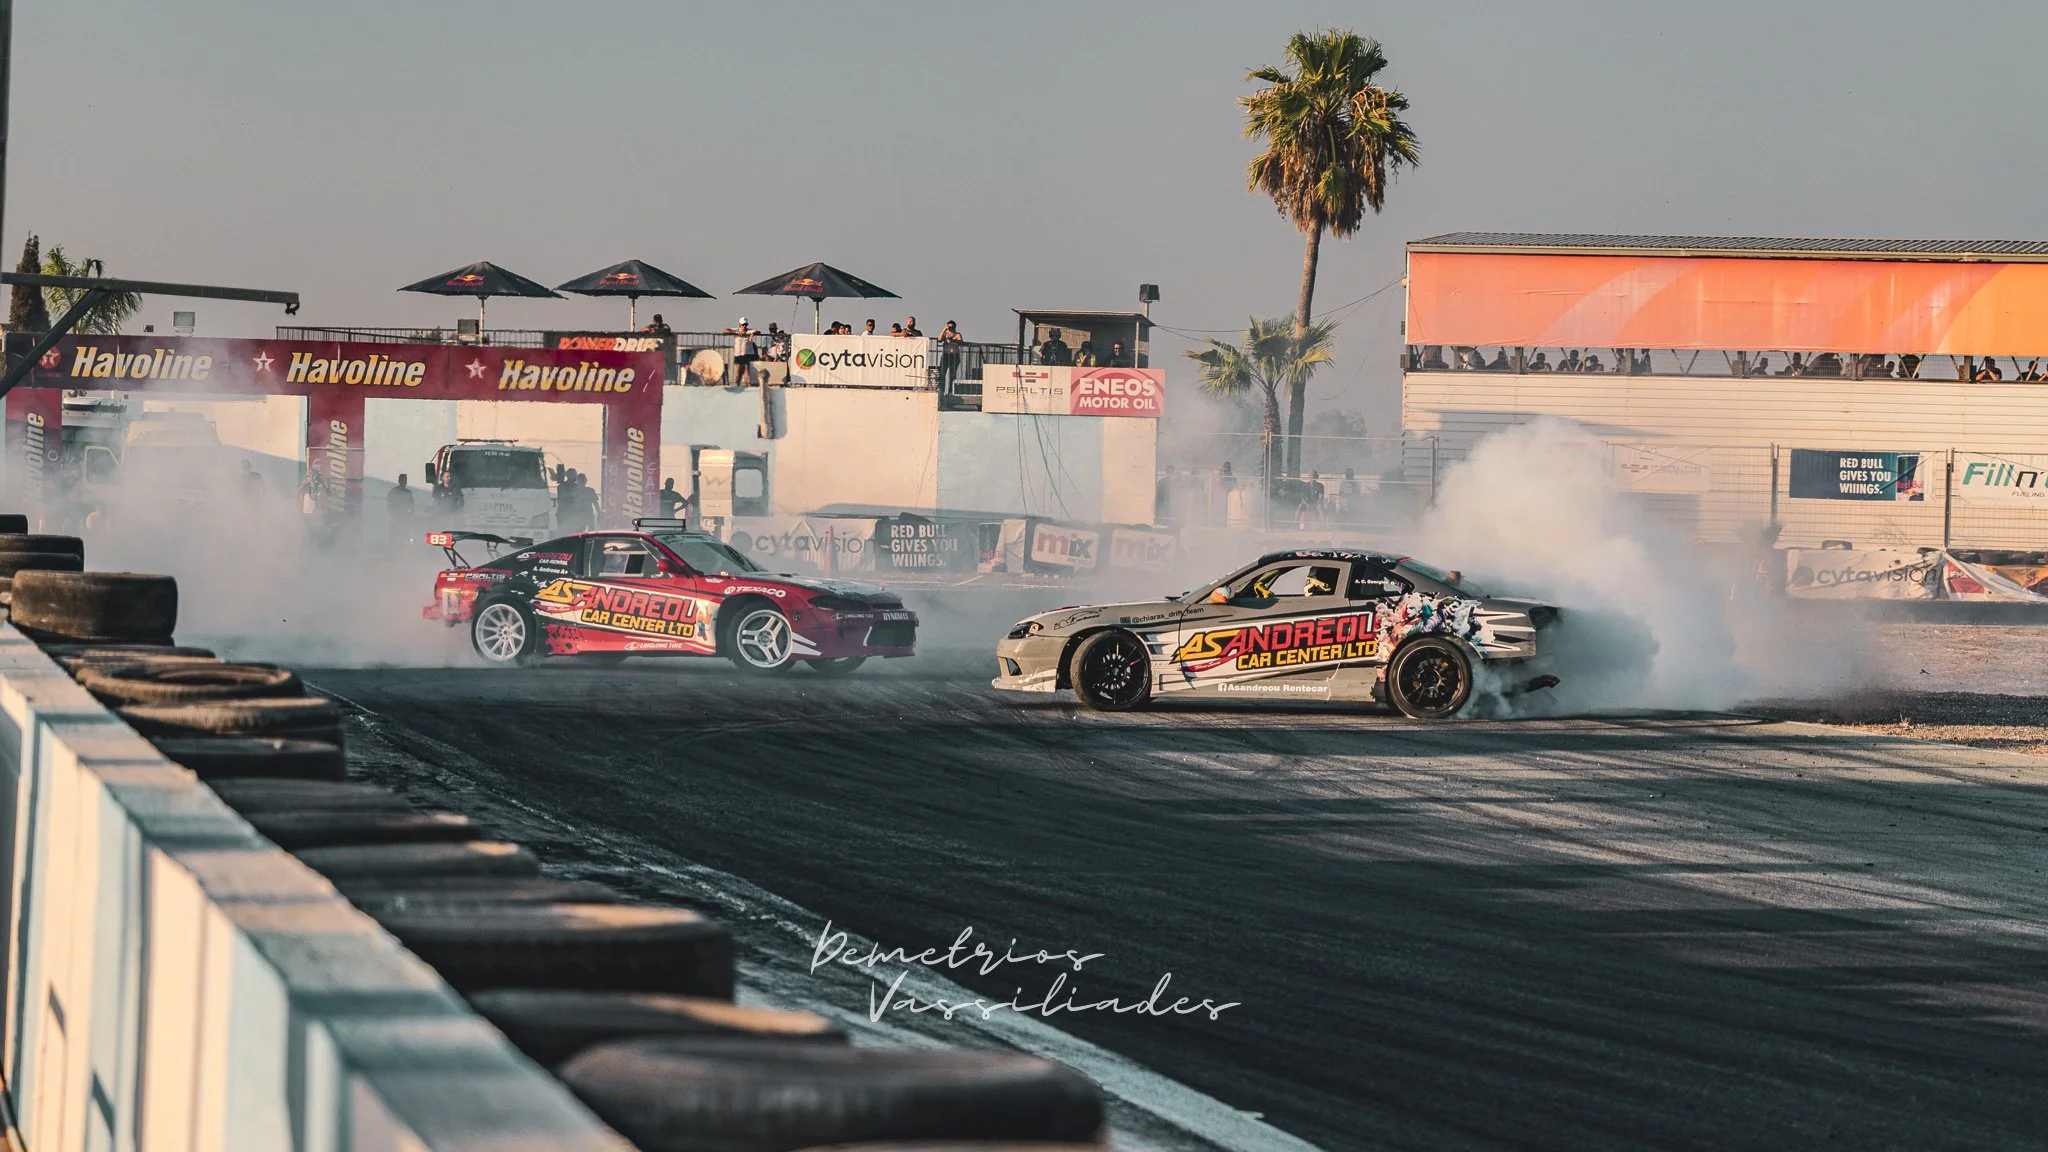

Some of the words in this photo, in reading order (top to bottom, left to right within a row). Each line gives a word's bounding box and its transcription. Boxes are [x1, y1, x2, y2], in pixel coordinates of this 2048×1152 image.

[70, 346, 212, 380] Havoline
[286, 352, 426, 387] Havoline
[818, 348, 925, 371] cytavision
[498, 359, 635, 393] Havoline
[996, 386, 1064, 395] PSALTIS
[1079, 377, 1155, 397] ENEOS
[1079, 396, 1129, 409] MOTOR
[1133, 397, 1155, 410] OIL
[22, 412, 45, 502] avoline
[1839, 457, 1858, 468] RED
[1861, 458, 1883, 469] BULL
[622, 426, 645, 518] Havoline
[1839, 470, 1868, 481] GIVES
[1870, 471, 1891, 482] YOU
[1839, 483, 1883, 494] WIIINGS.
[429, 534, 447, 545] 83
[891, 524, 914, 538] RED
[919, 524, 947, 538] BULL
[891, 538, 928, 552] GIVES
[931, 538, 958, 552] YOU
[1037, 532, 1093, 559] mix
[1817, 564, 1937, 586] cytavision
[736, 586, 786, 598] TEXACO
[581, 608, 609, 624] CAR
[611, 614, 668, 634] CENTER
[667, 621, 694, 638] LTD
[1237, 652, 1273, 670] CAR
[1276, 646, 1343, 665] CENTER
[1347, 641, 1378, 658] LTD
[1228, 683, 1280, 693] Asandreou
